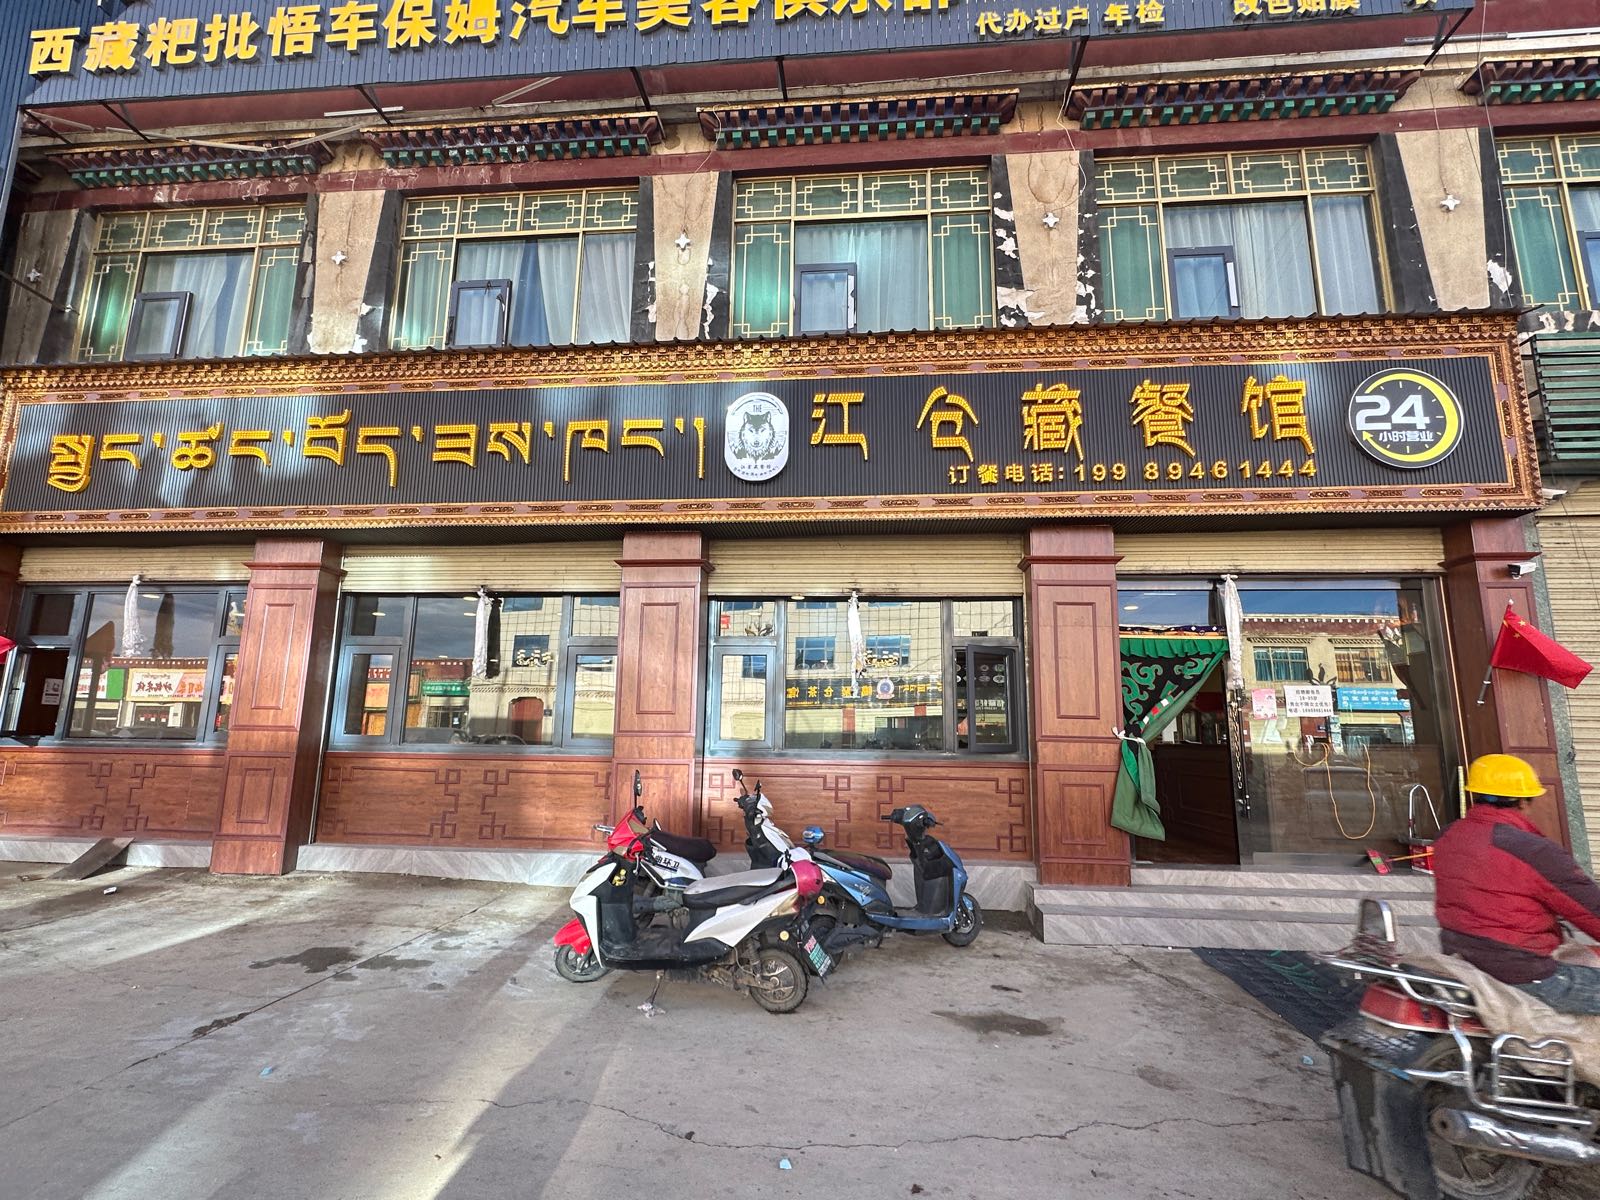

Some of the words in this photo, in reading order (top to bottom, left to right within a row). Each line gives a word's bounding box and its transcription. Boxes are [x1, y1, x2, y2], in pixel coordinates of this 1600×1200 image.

[976, 5, 1090, 37] 代办过户
[1104, 0, 1165, 27] 年检
[810, 374, 1317, 463] 江仓藏餐馆
[1355, 394, 1431, 431] 24
[1378, 430, 1435, 442] 小时营业
